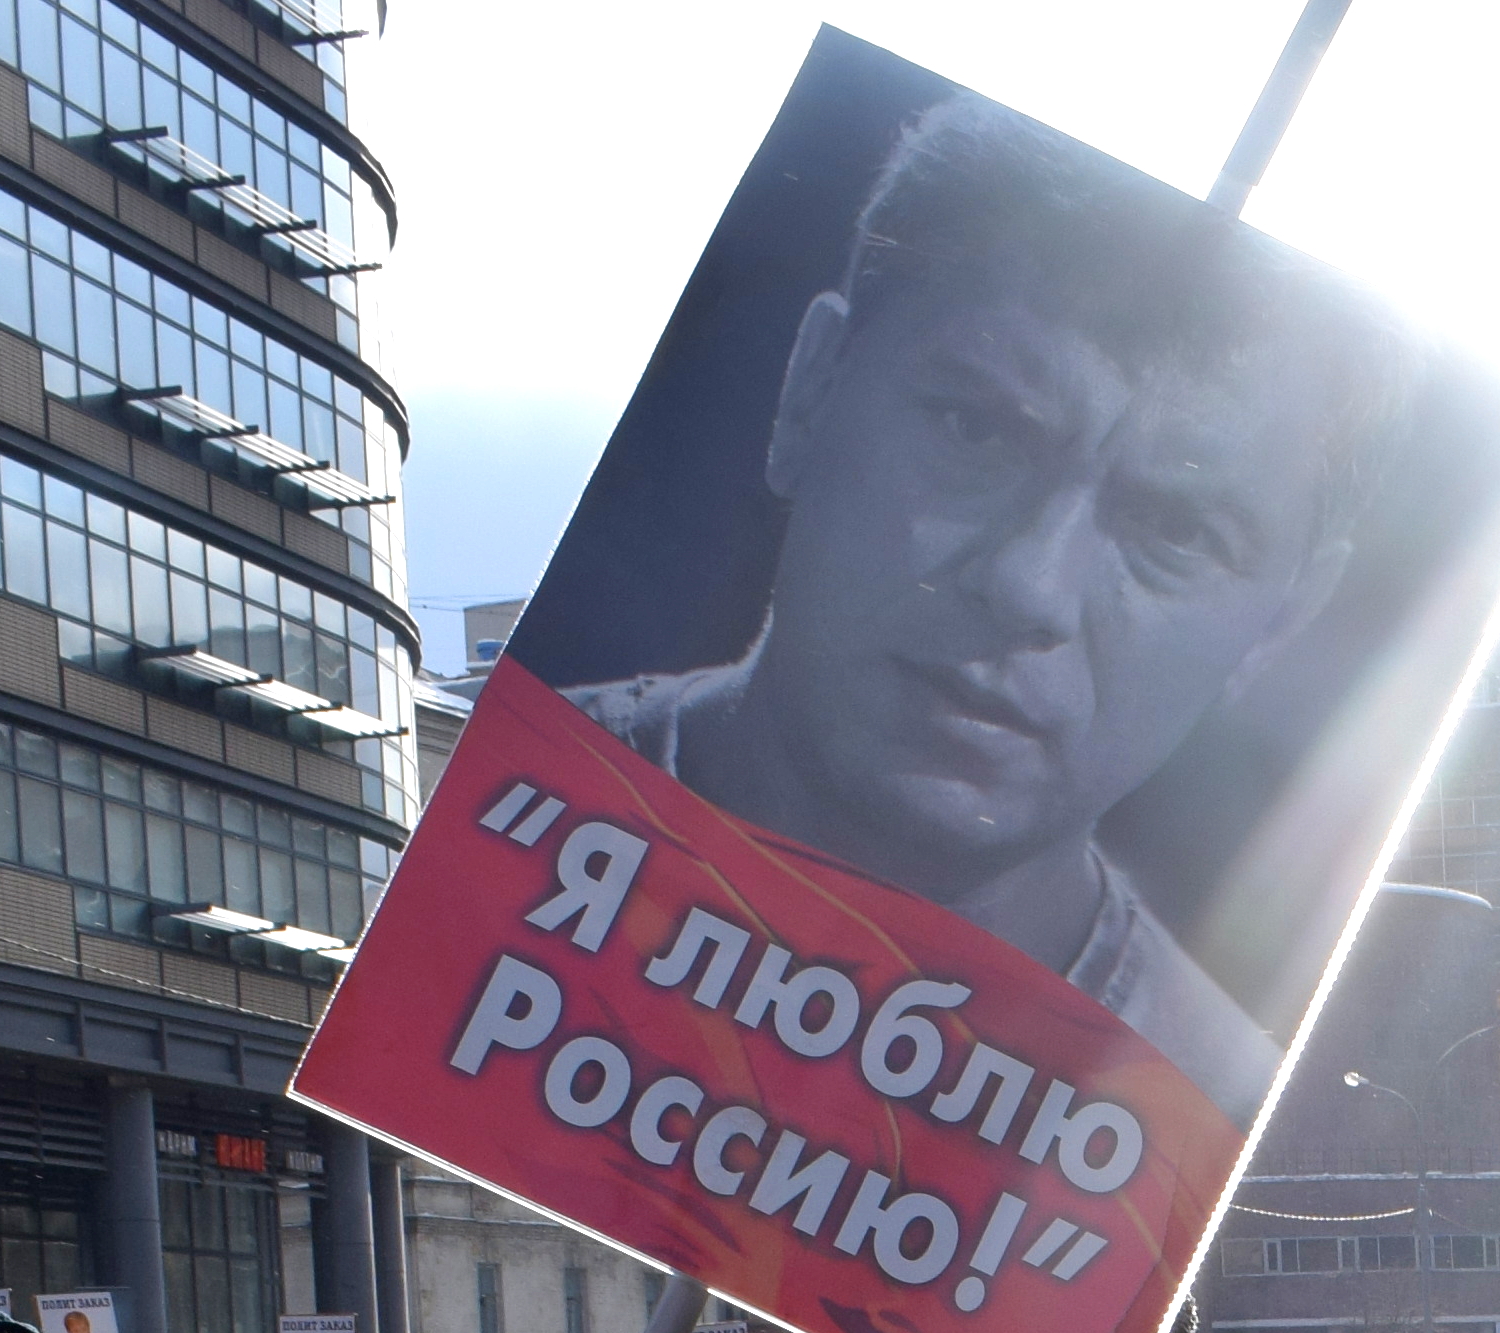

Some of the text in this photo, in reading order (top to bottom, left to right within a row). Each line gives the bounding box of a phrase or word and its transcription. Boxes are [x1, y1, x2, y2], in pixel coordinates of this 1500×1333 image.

[477, 782, 1145, 1193] "Я люблю
[450, 953, 1109, 1313] Россию!"
[42, 1297, 111, 1310] ПОЛИТ ЗАКАЗ
[282, 1320, 353, 1331] ПОЛИТ ЗАКАЗ
